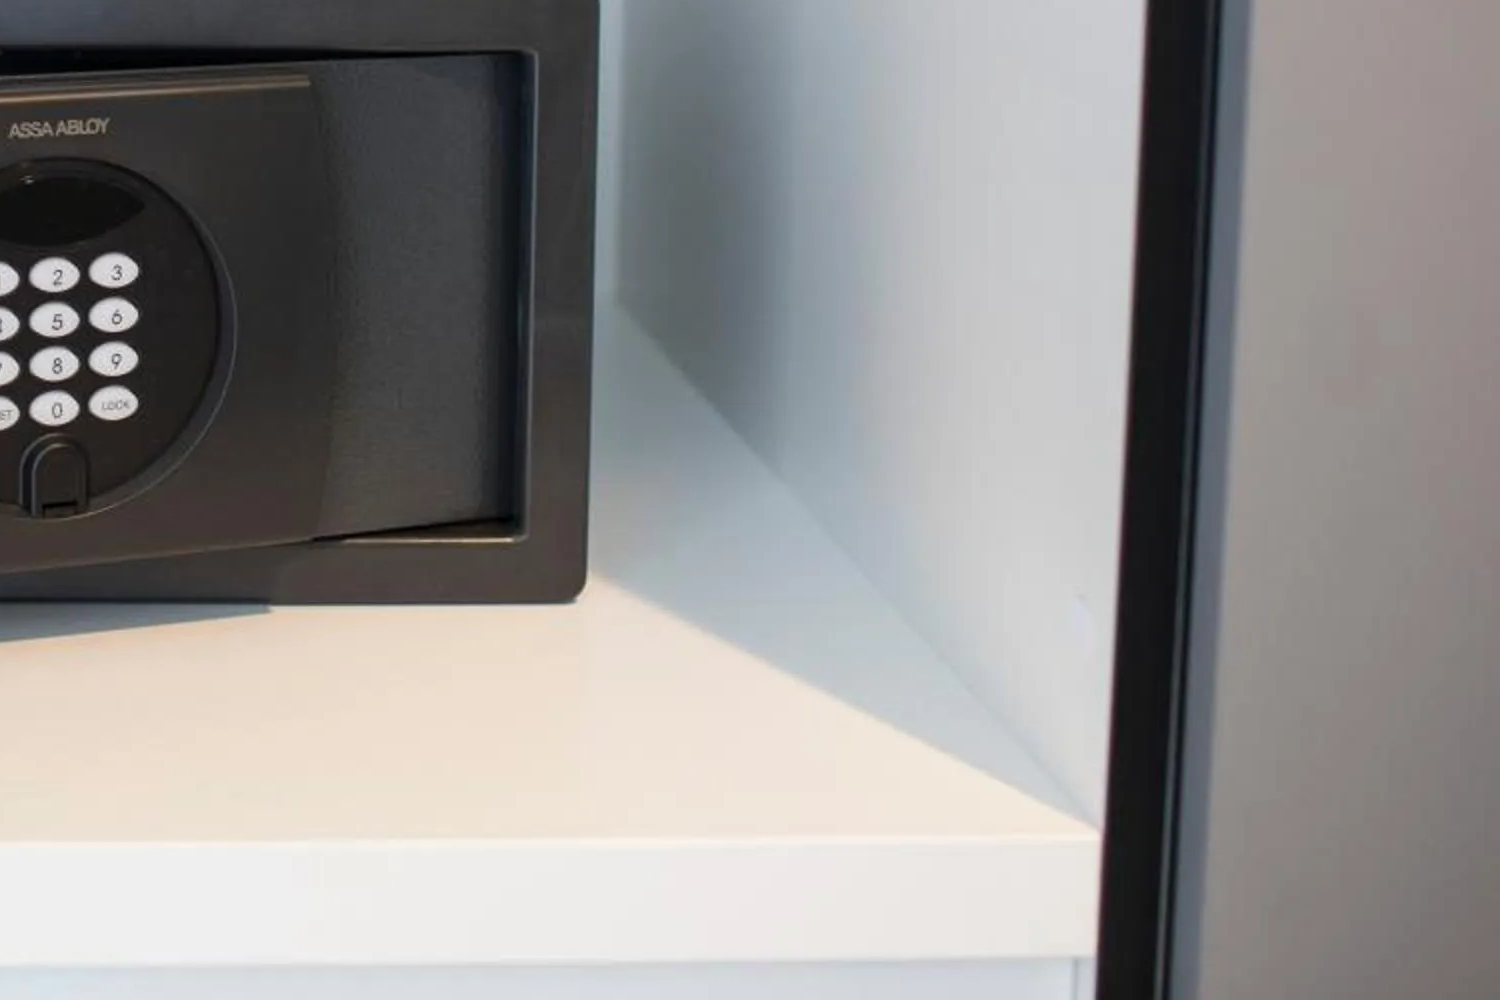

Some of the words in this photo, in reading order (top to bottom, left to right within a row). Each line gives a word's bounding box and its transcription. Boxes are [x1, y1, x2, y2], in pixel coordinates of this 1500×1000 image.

[8, 121, 54, 139] ASSA
[55, 117, 111, 136] ABLOY
[53, 269, 63, 286] 2
[111, 264, 123, 281] 3
[52, 313, 63, 331] 5
[111, 309, 123, 325] 6
[52, 357, 63, 375] 8
[111, 353, 123, 370] 9
[52, 402, 63, 419] 0
[101, 400, 130, 412] LOCK
